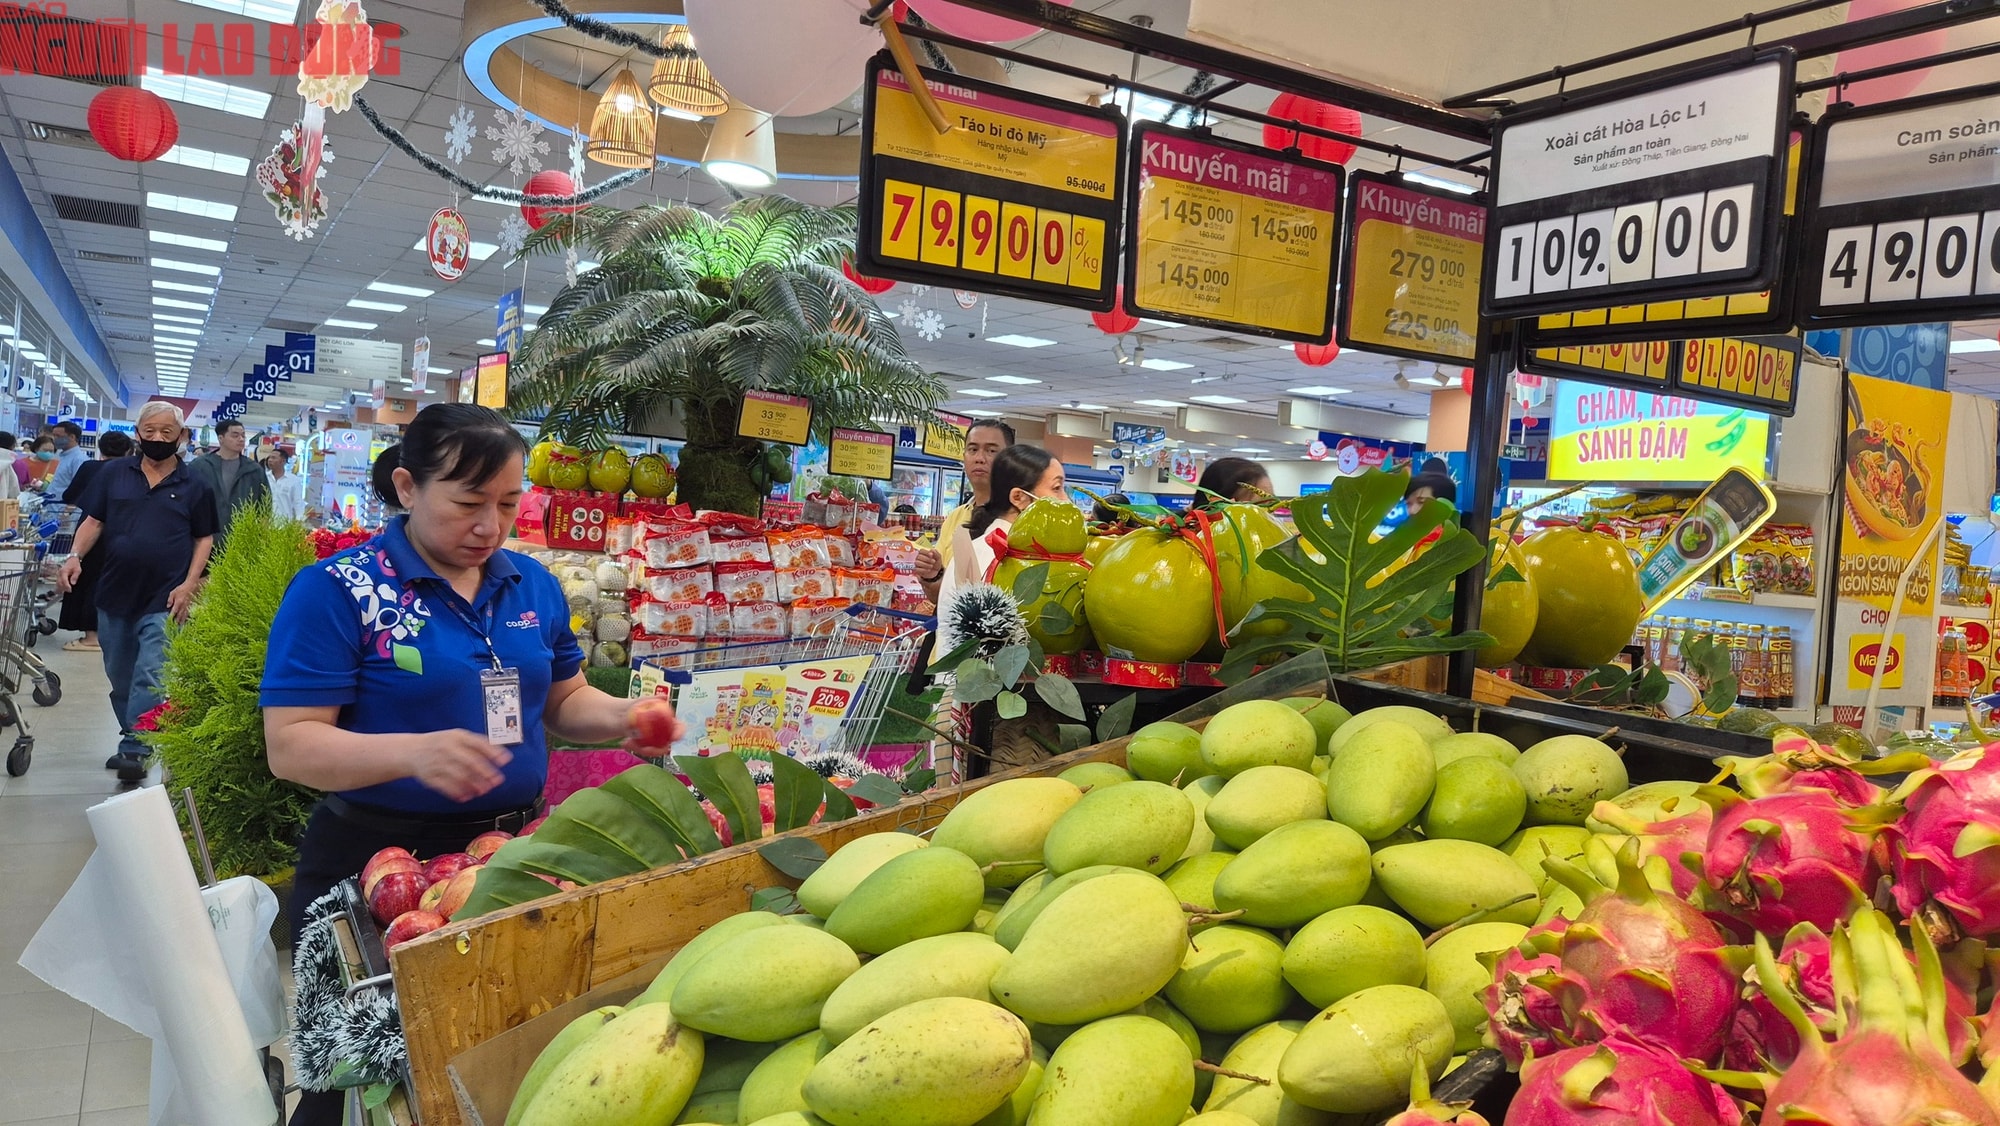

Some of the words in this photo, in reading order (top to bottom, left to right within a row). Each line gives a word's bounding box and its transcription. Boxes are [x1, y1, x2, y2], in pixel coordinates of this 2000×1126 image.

[959, 116, 985, 134] Táo
[989, 122, 1002, 137] bi
[1007, 127, 1023, 142] đỏ
[1027, 131, 1047, 148] Mỹ
[1544, 132, 1578, 152] Xoài
[1583, 126, 1607, 144] cát
[1612, 118, 1644, 137] Hòa
[1650, 109, 1681, 130] Lộc
[1687, 101, 1707, 119] L1
[1897, 128, 1942, 147] Cam
[977, 138, 994, 152] Hàng
[995, 144, 1012, 155] nhập
[1573, 153, 1594, 166] Sản
[1596, 145, 1626, 163] phẩm
[1629, 145, 1643, 154] an
[1646, 137, 1671, 151] toàn
[1141, 139, 1238, 184] Khuyến
[1246, 167, 1289, 194] mãi
[1928, 152, 1955, 164] Sản
[1066, 176, 1106, 193] 95.000đ
[1160, 196, 1202, 227] 145
[1207, 204, 1234, 224] 000
[1360, 186, 1442, 225] Khuyến
[1448, 211, 1485, 235] mãi
[890, 193, 1064, 266] 79.900
[1251, 214, 1289, 243] 145
[1294, 223, 1317, 241] 000
[1511, 198, 1739, 282] 109.000
[1389, 248, 1435, 282] 279
[1440, 259, 1465, 278] 000
[1829, 225, 2000, 288] 49.0
[1157, 260, 1198, 290] 145
[1203, 268, 1229, 286] 000
[1383, 308, 1428, 341] 225
[1434, 316, 1459, 335] 000
[289, 353, 311, 371] 01
[1686, 339, 1774, 387] 81.000
[267, 364, 289, 380] 02
[255, 379, 274, 394] 03
[231, 402, 246, 413] 05
[761, 410, 774, 419] 33
[758, 427, 770, 437] 33
[1577, 425, 1633, 464] SÁNH
[1639, 422, 1689, 464] ĐẬM
[666, 531, 692, 545] Karo
[727, 540, 752, 549] Karo
[787, 538, 811, 550] Karo
[1868, 553, 1901, 572] CƠM
[671, 570, 697, 583] Karo
[735, 570, 760, 581] Karo
[791, 569, 816, 580] Karo
[858, 577, 881, 587] Karo
[664, 601, 691, 612] Karo
[751, 604, 774, 614] Karo
[810, 605, 835, 616] Karo
[651, 638, 679, 649] Karo
[833, 669, 855, 683] Zoo
[816, 692, 845, 708] 20%
